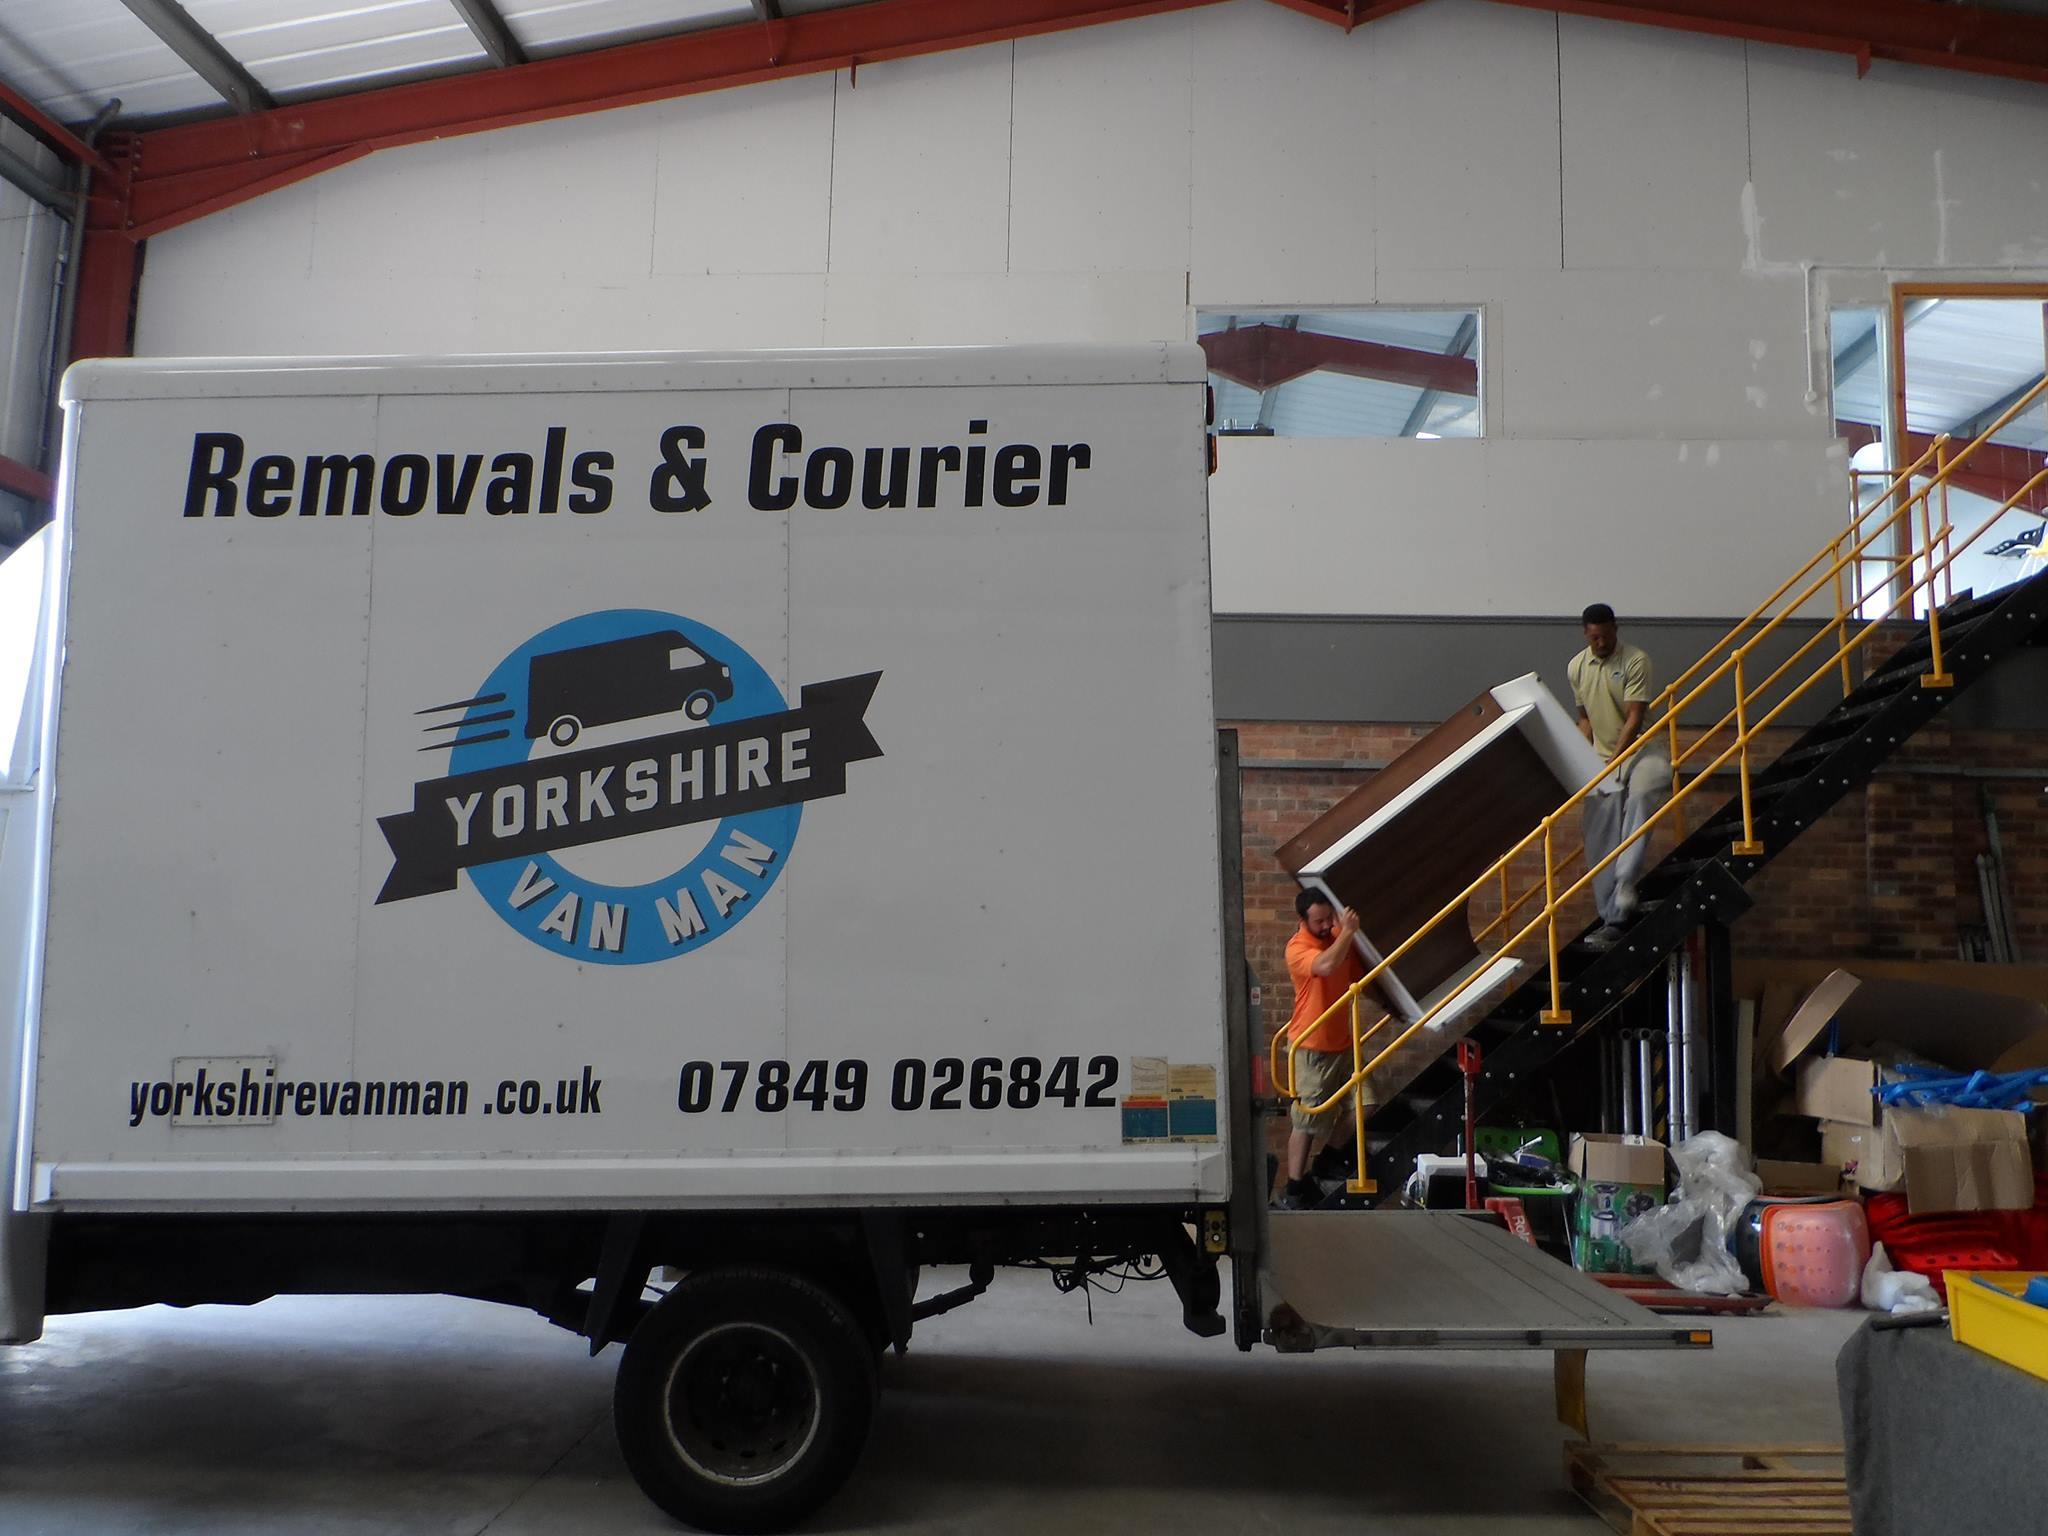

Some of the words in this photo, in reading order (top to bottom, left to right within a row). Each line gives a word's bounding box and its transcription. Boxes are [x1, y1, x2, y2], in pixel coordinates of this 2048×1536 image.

[183, 426, 615, 518] Removals
[649, 425, 712, 513] &
[747, 419, 1092, 512] Courier
[446, 728, 811, 846] YORKSHIRE
[507, 861, 629, 953] VAN
[655, 829, 778, 945] MAN
[129, 1068, 469, 1128] yorkshirevanman
[483, 1065, 602, 1115] .co.uk
[677, 1059, 869, 1114] 07849
[891, 1055, 1119, 1112] 026842
